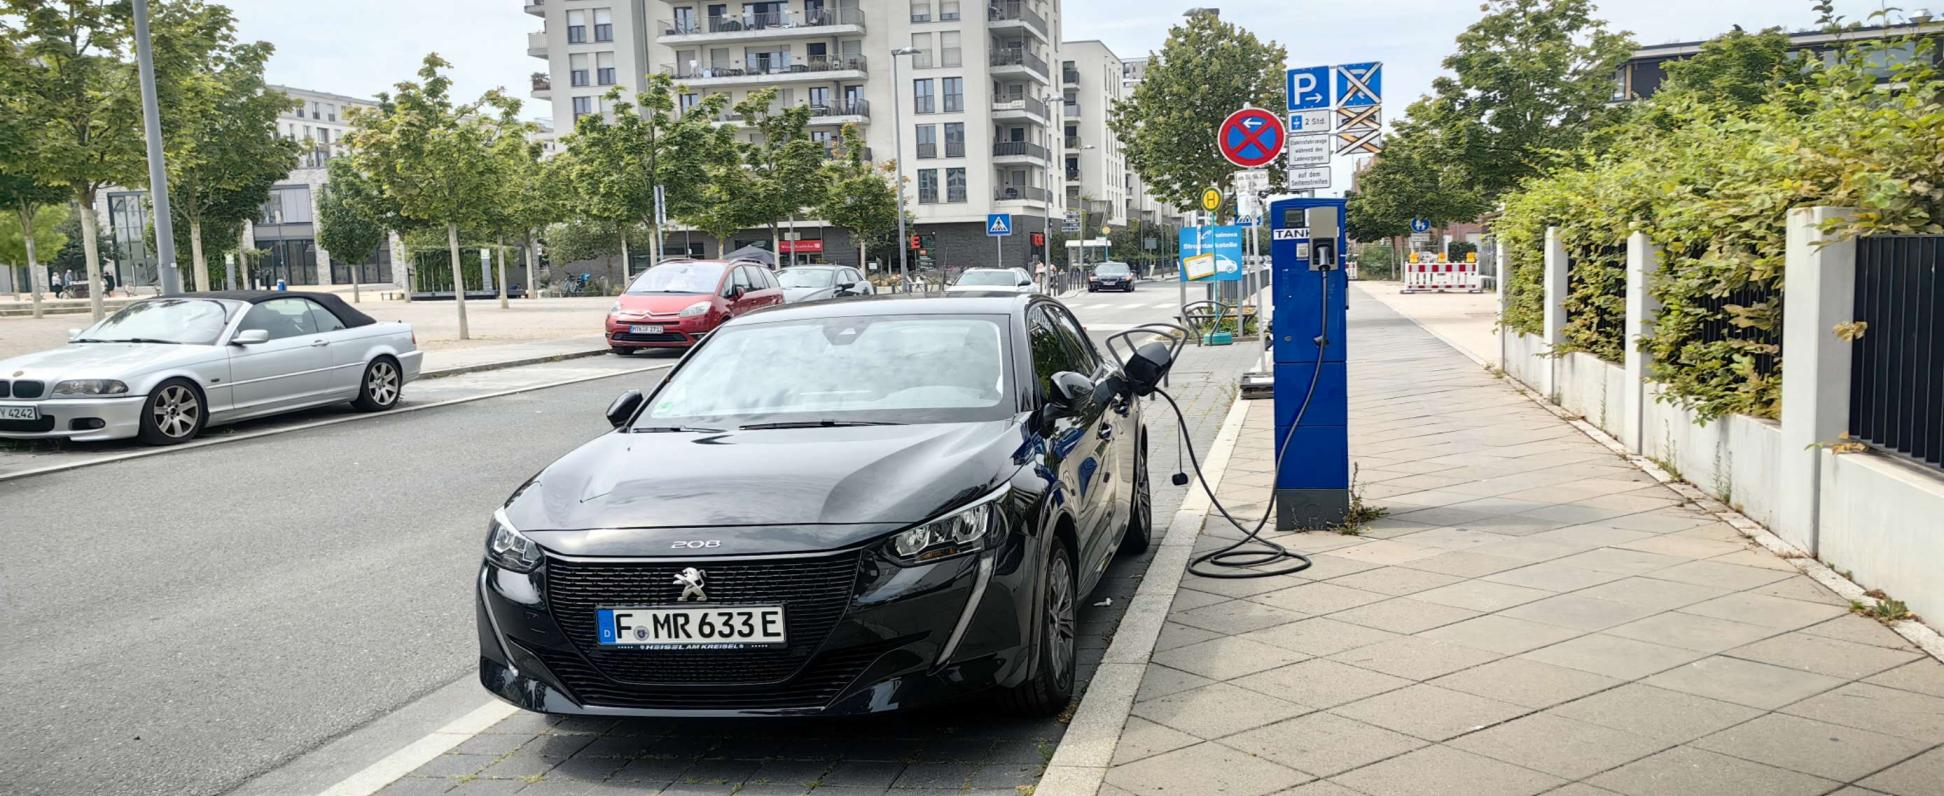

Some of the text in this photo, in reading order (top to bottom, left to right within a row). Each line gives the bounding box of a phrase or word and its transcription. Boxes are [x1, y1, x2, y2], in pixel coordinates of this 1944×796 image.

[1293, 72, 1317, 106] P
[1305, 118, 1310, 126] 2
[1291, 177, 1328, 187] Seitenstreifen
[1206, 192, 1216, 207] H
[9, 408, 33, 419] 4242
[671, 539, 721, 549] 208
[603, 611, 782, 639] D F MR 633 E
